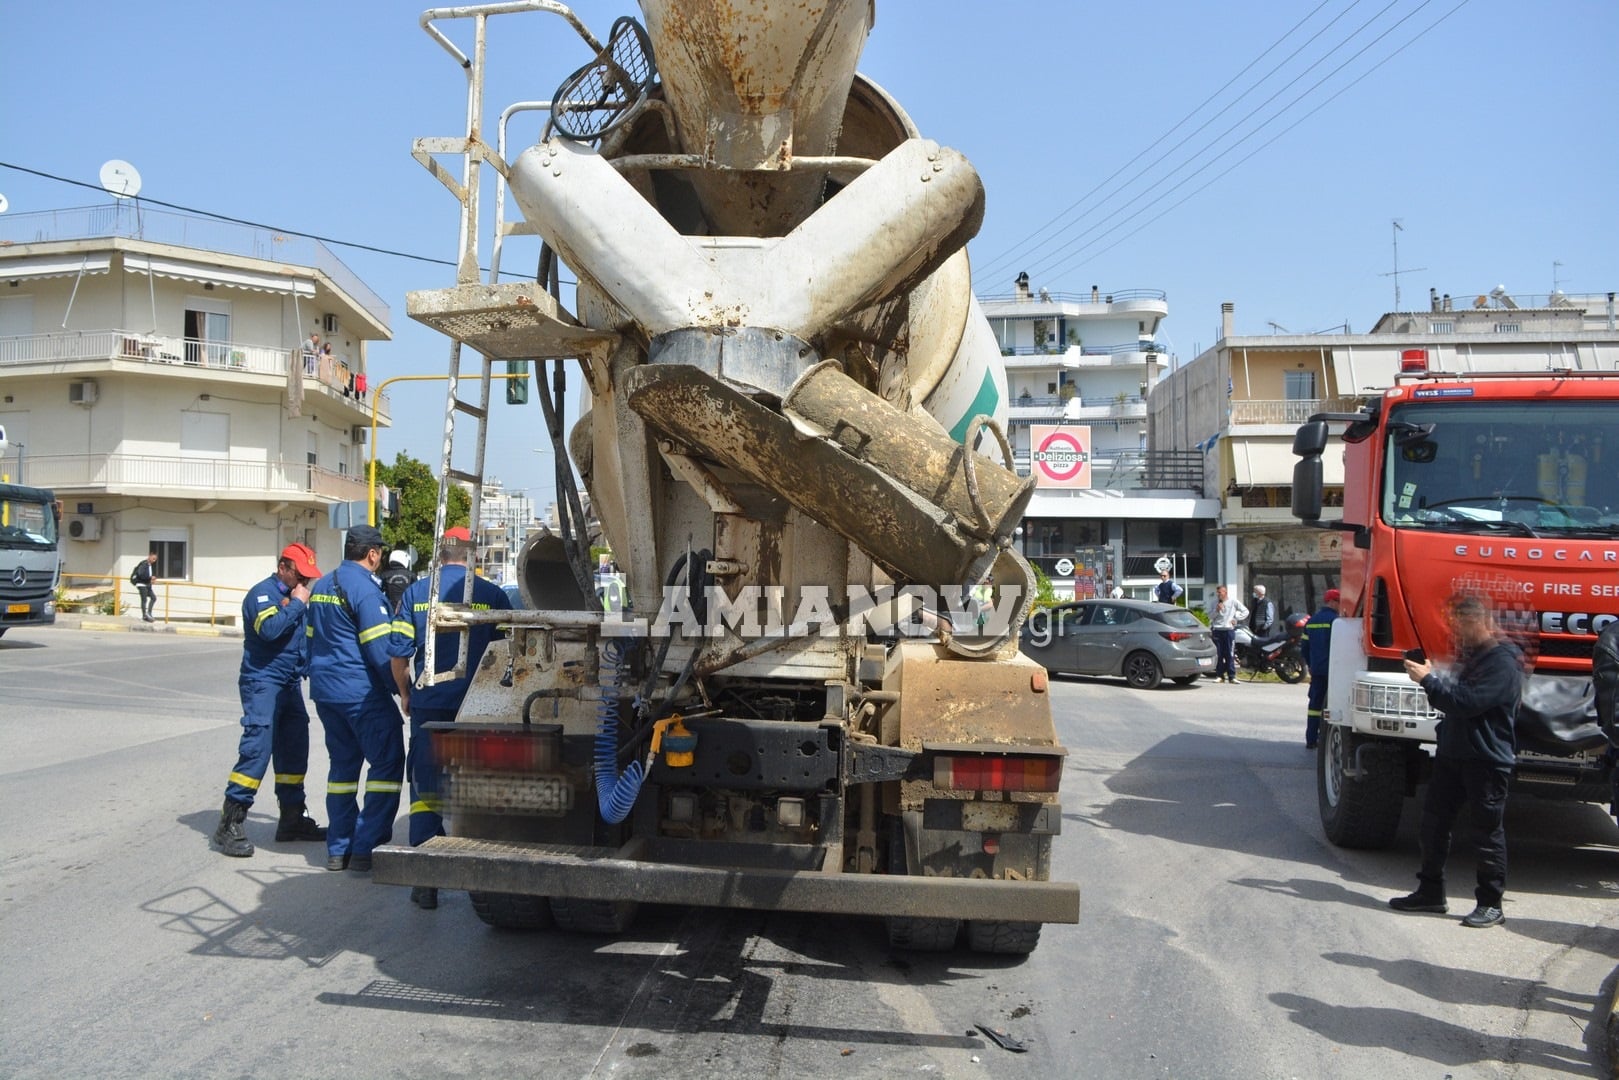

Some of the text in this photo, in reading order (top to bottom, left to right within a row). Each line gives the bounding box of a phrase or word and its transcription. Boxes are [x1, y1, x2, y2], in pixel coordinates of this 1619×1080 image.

[1039, 452, 1082, 461] Deliziosa
[1455, 545, 1617, 561] EUROCAR
[1543, 583, 1582, 595] FIRE
